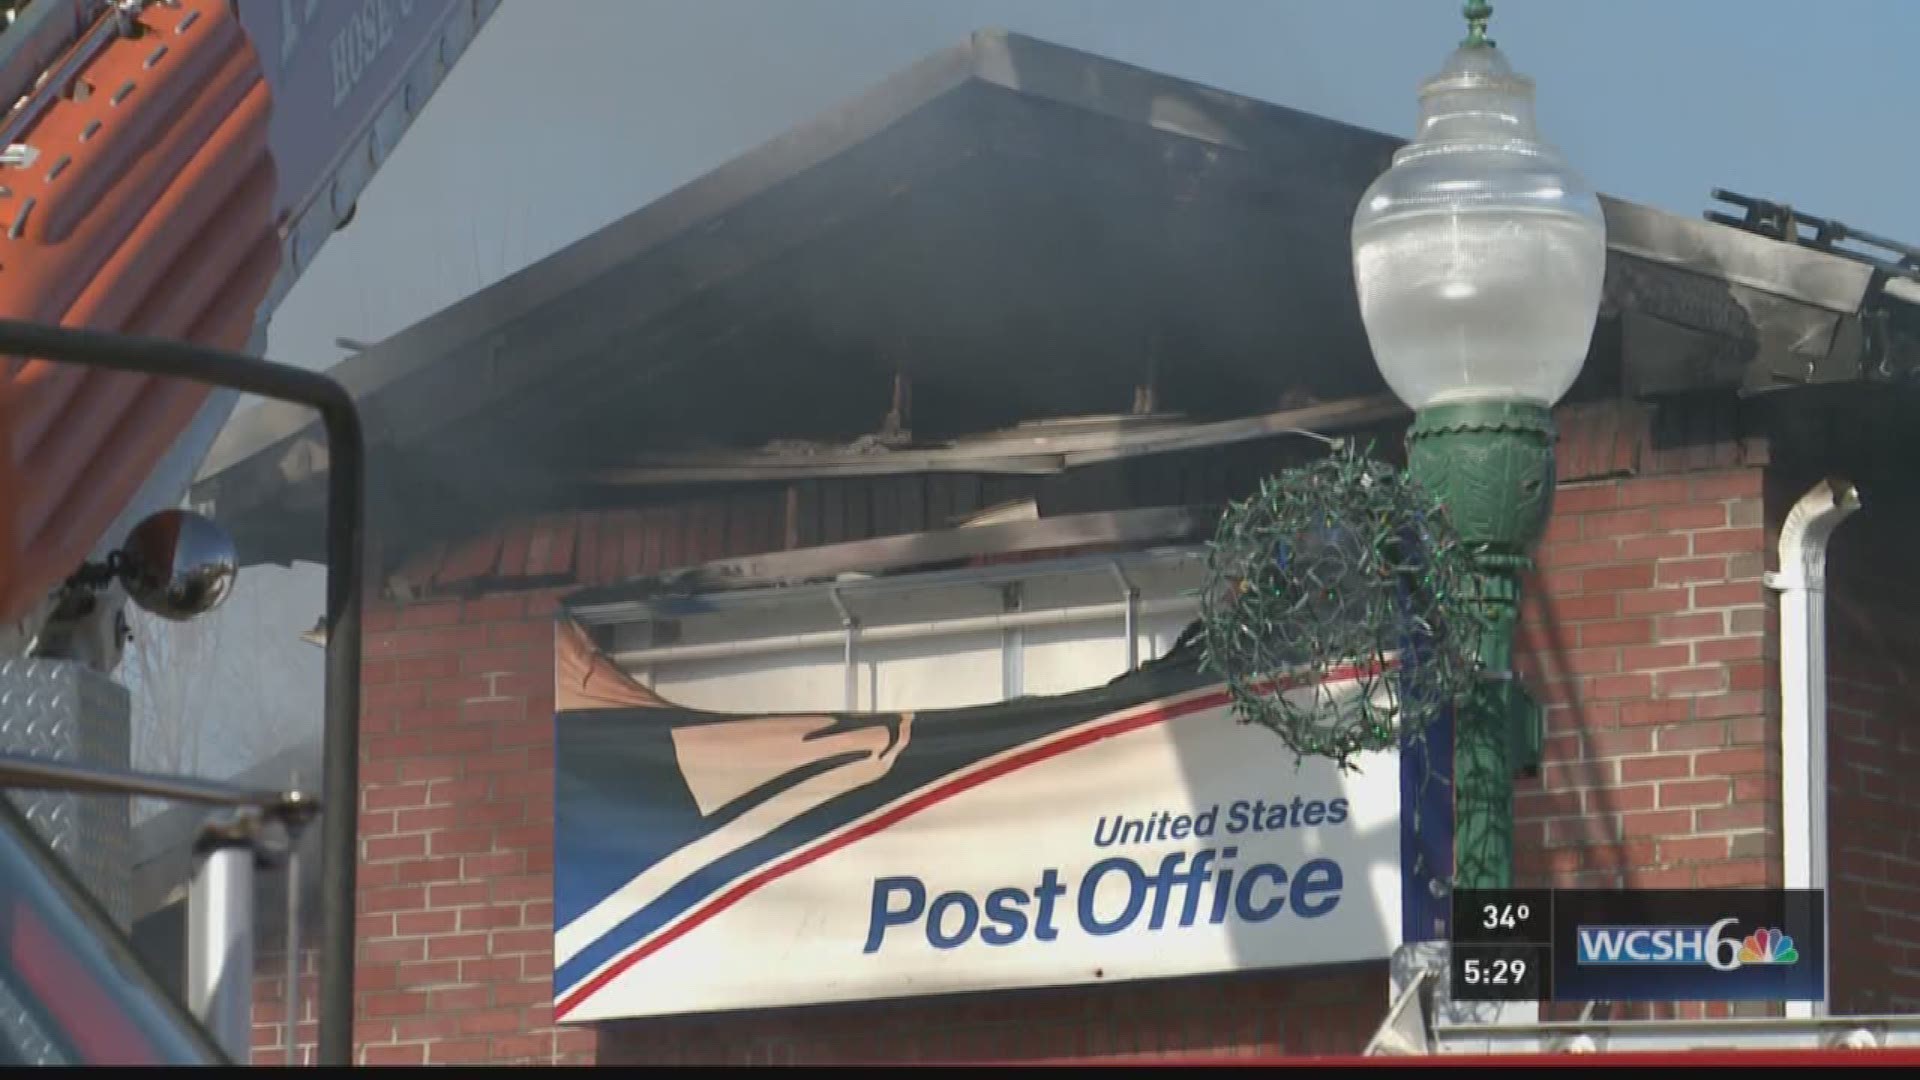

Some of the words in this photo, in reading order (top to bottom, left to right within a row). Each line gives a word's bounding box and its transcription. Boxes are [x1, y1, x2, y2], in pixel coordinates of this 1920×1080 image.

[1093, 806, 1219, 847] United
[1225, 797, 1349, 835] States
[863, 868, 1066, 954] Post
[1077, 846, 1344, 936] Office
